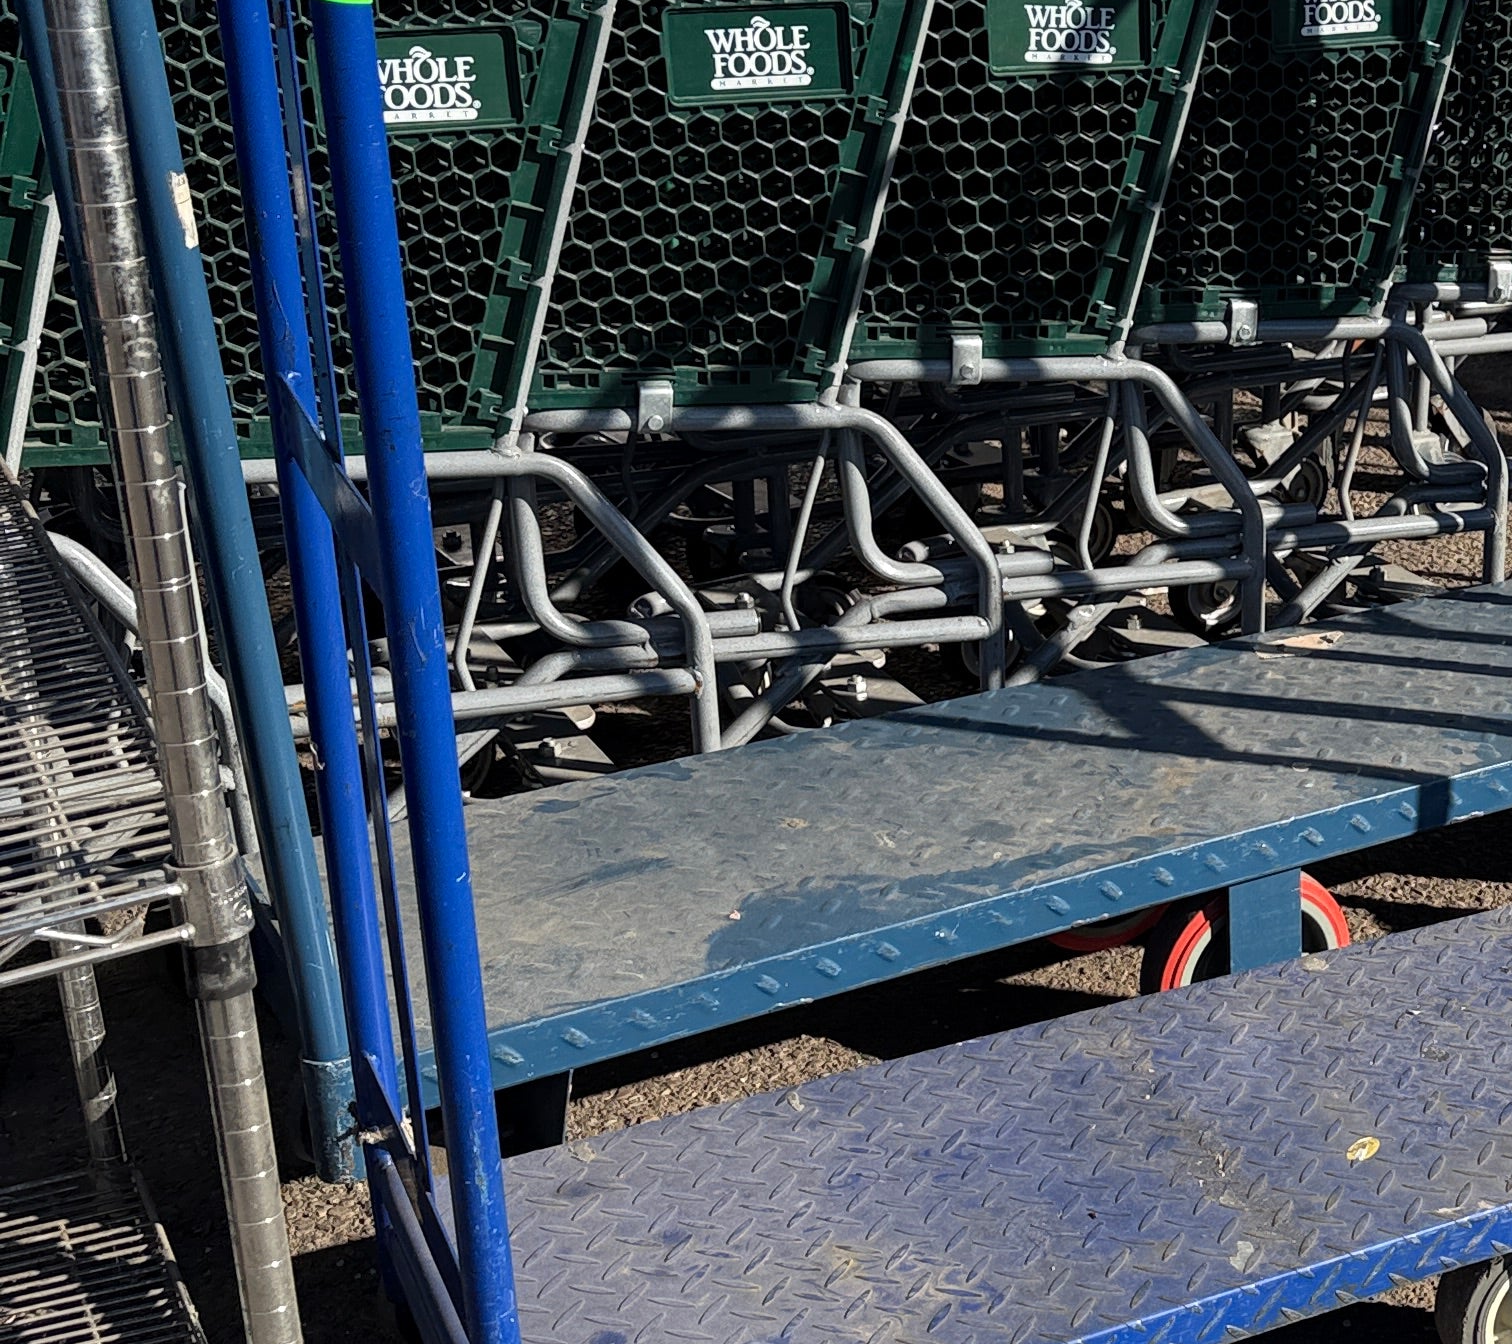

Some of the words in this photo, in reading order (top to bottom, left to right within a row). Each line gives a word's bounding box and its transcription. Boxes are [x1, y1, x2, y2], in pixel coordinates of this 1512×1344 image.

[1024, 4, 1116, 30] WHOLE
[1303, 0, 1376, 26] FOODS
[704, 25, 811, 53] WHOLE
[1028, 28, 1111, 53] FOODS
[712, 49, 807, 78] FOODS
[380, 82, 473, 110] OODS
